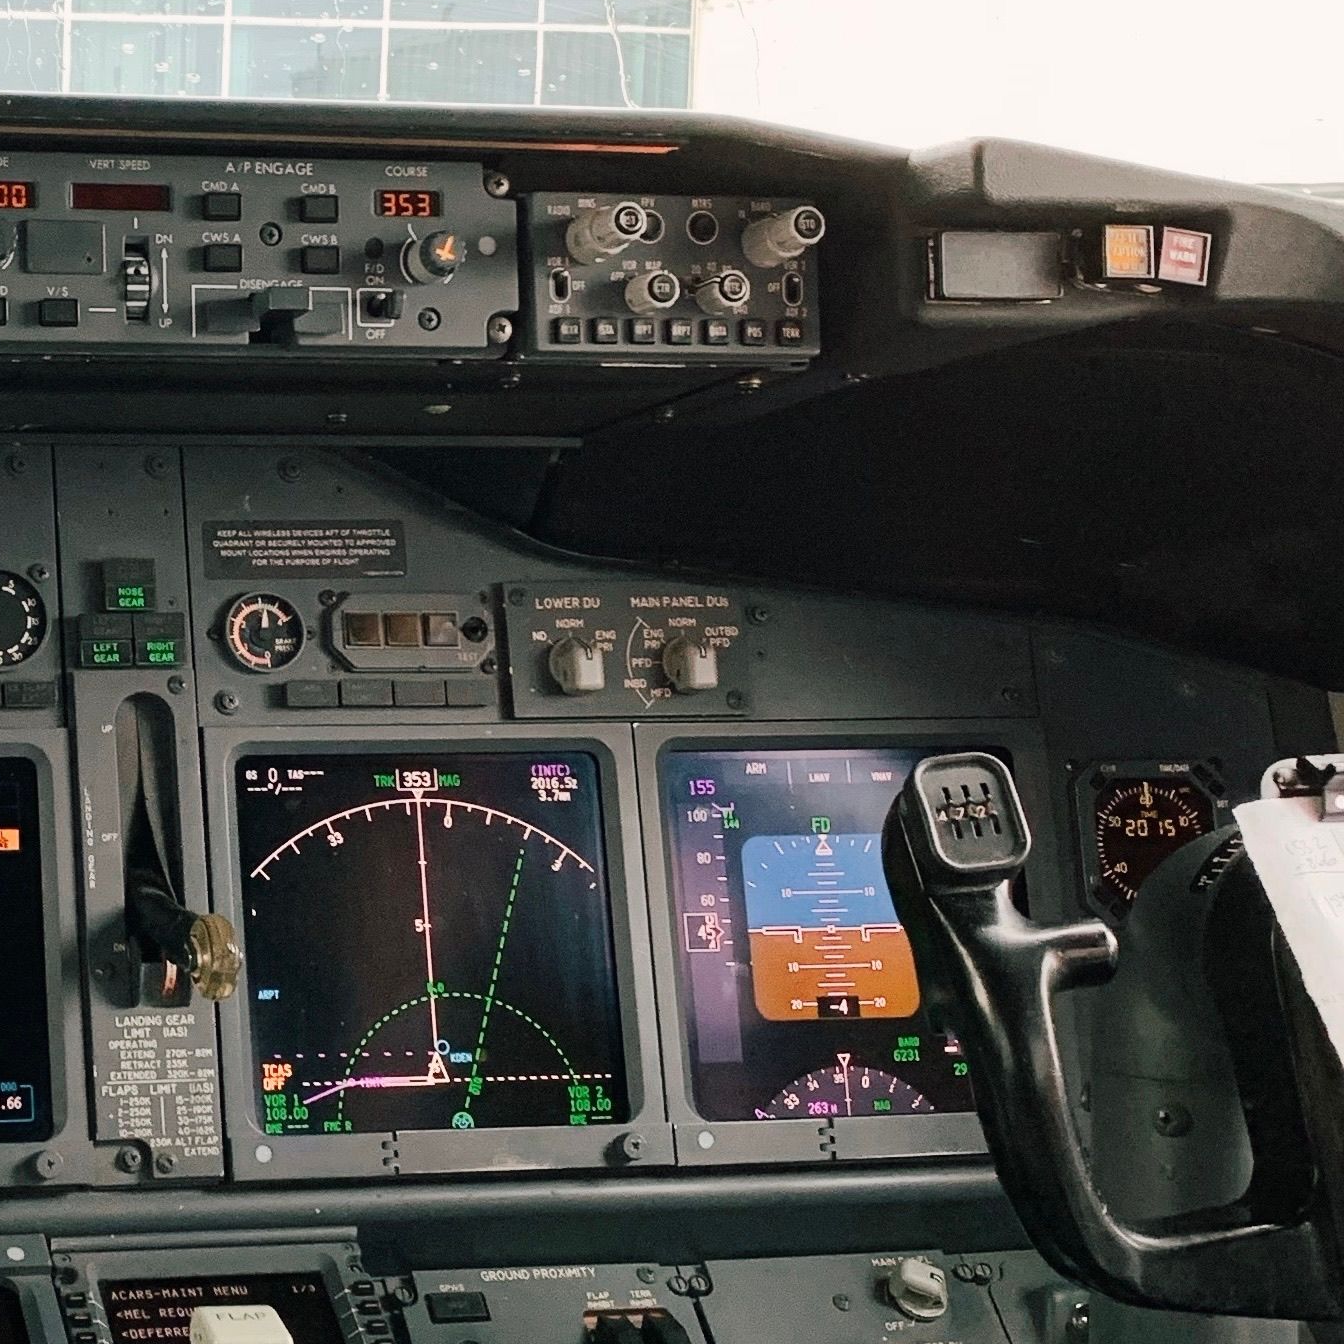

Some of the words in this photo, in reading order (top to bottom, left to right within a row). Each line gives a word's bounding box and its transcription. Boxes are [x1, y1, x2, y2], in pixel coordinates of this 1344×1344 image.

[256, 163, 314, 176] ENGAGE
[385, 166, 428, 177] COURSE
[384, 193, 431, 216] 353
[535, 597, 577, 609] LOWER
[582, 597, 600, 609] DU
[630, 597, 660, 608] MAIN
[664, 597, 696, 608] PANEL
[93, 643, 118, 652] LEFT
[147, 642, 176, 653] RIGHT
[94, 653, 120, 663] GEAR
[148, 652, 175, 663] GEAR
[374, 775, 395, 789] TRK
[403, 771, 432, 787] 353
[439, 775, 461, 788] MAG
[688, 779, 716, 797] 155
[811, 817, 831, 833] FD
[115, 1016, 162, 1027] LANDING
[166, 1015, 195, 1026] GEAR
[263, 1064, 293, 1078] TCAS
[263, 1078, 285, 1091] OFF
[265, 1108, 309, 1121] 108.00
[480, 1270, 531, 1283] GROUND
[534, 1266, 596, 1280] PROXIMITY
[214, 1286, 248, 1296] MENU
[216, 1310, 267, 1322] FLAP
